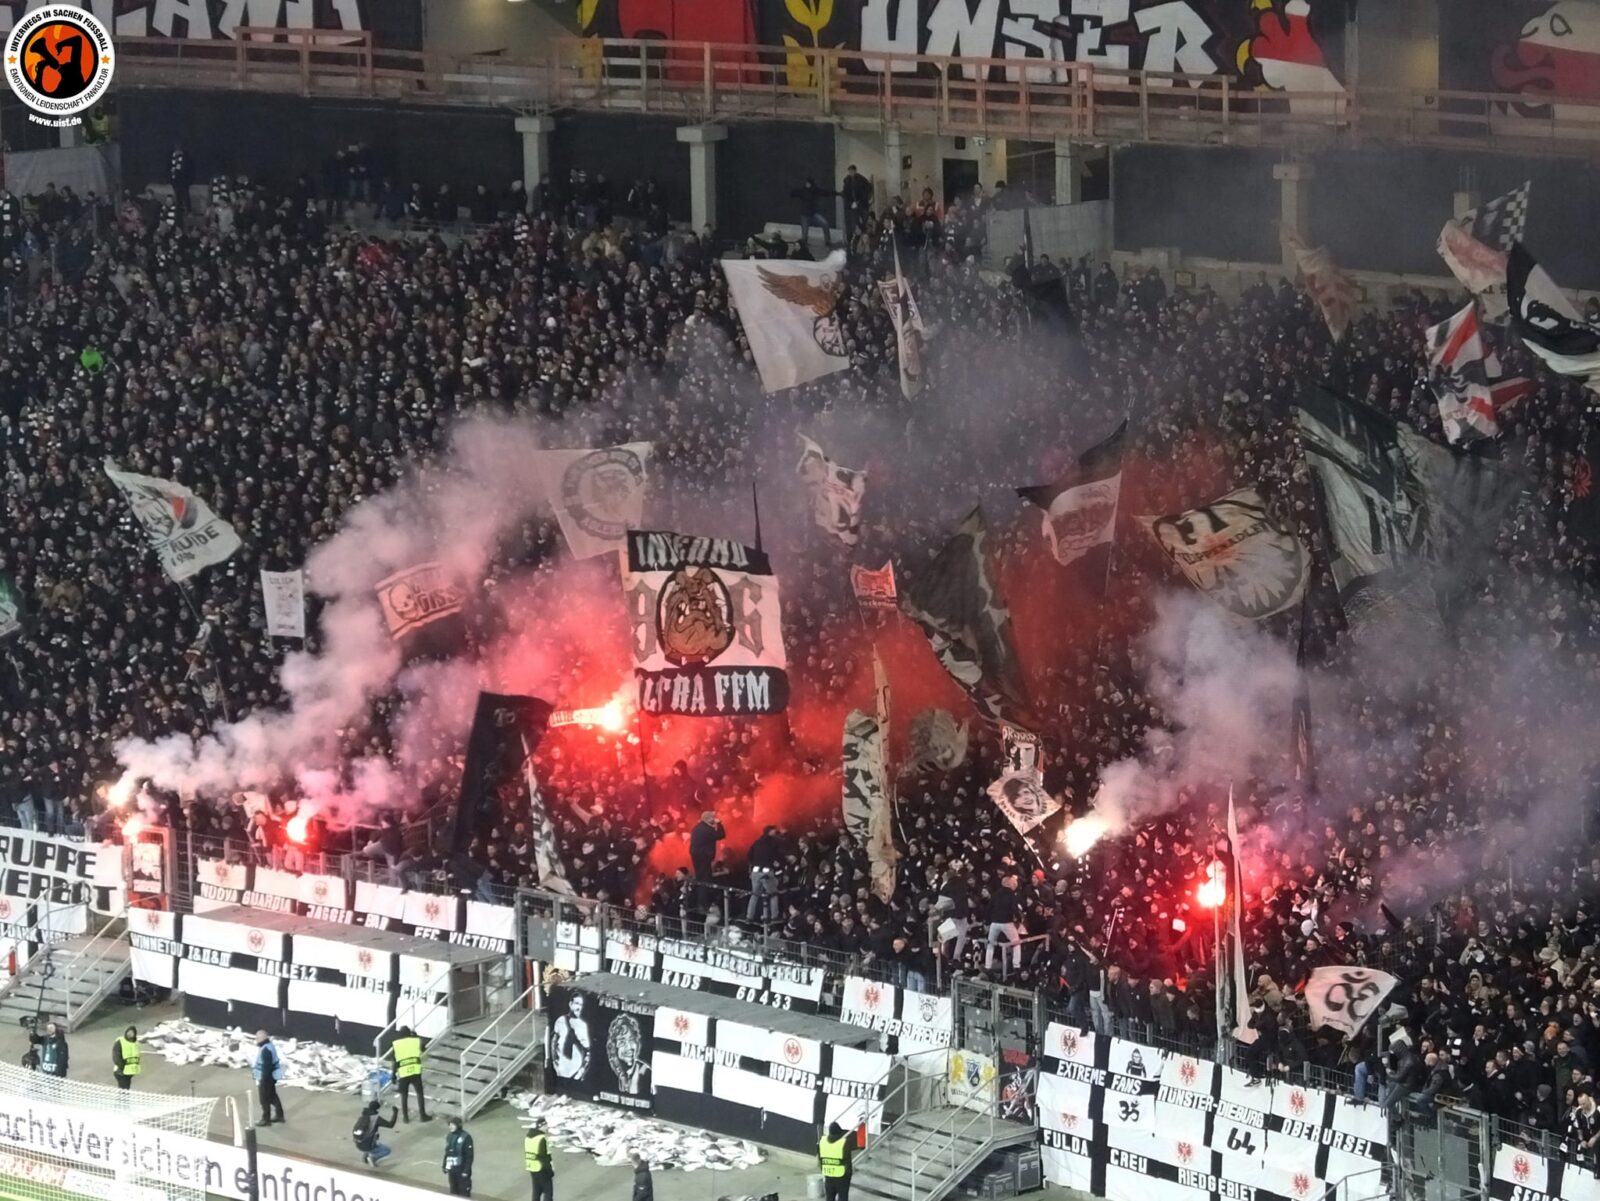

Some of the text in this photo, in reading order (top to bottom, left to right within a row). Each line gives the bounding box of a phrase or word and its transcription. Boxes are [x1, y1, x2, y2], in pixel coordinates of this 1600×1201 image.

[860, 0, 1220, 87] UNSER
[161, 525, 219, 553] RUIDE
[714, 670, 770, 712] FFM
[0, 868, 117, 911] ERBOT
[201, 884, 291, 913] NUOVA GUARDIA
[130, 932, 184, 957] WINNETOU
[449, 931, 507, 954] VICTORIA
[658, 941, 704, 963] GRUPPE
[257, 958, 298, 979] HALLE
[610, 960, 652, 981] ULTRA
[661, 969, 700, 991] KADS
[346, 974, 390, 995] VILBEL
[840, 1009, 871, 1027] ULTRAS
[871, 1013, 901, 1036] NEVER
[680, 1042, 741, 1069] NACHWUX
[1056, 1060, 1107, 1087] EXTREME
[1110, 1077, 1142, 1095] FANS
[1043, 1129, 1089, 1157] FULDA
[1227, 1127, 1256, 1155] 64
[1281, 1118, 1373, 1159] OBERURSEL
[1110, 1147, 1148, 1174] CREW
[234, 1166, 380, 1201] enfach
[1177, 1168, 1257, 1201] RIEDGEBIET
